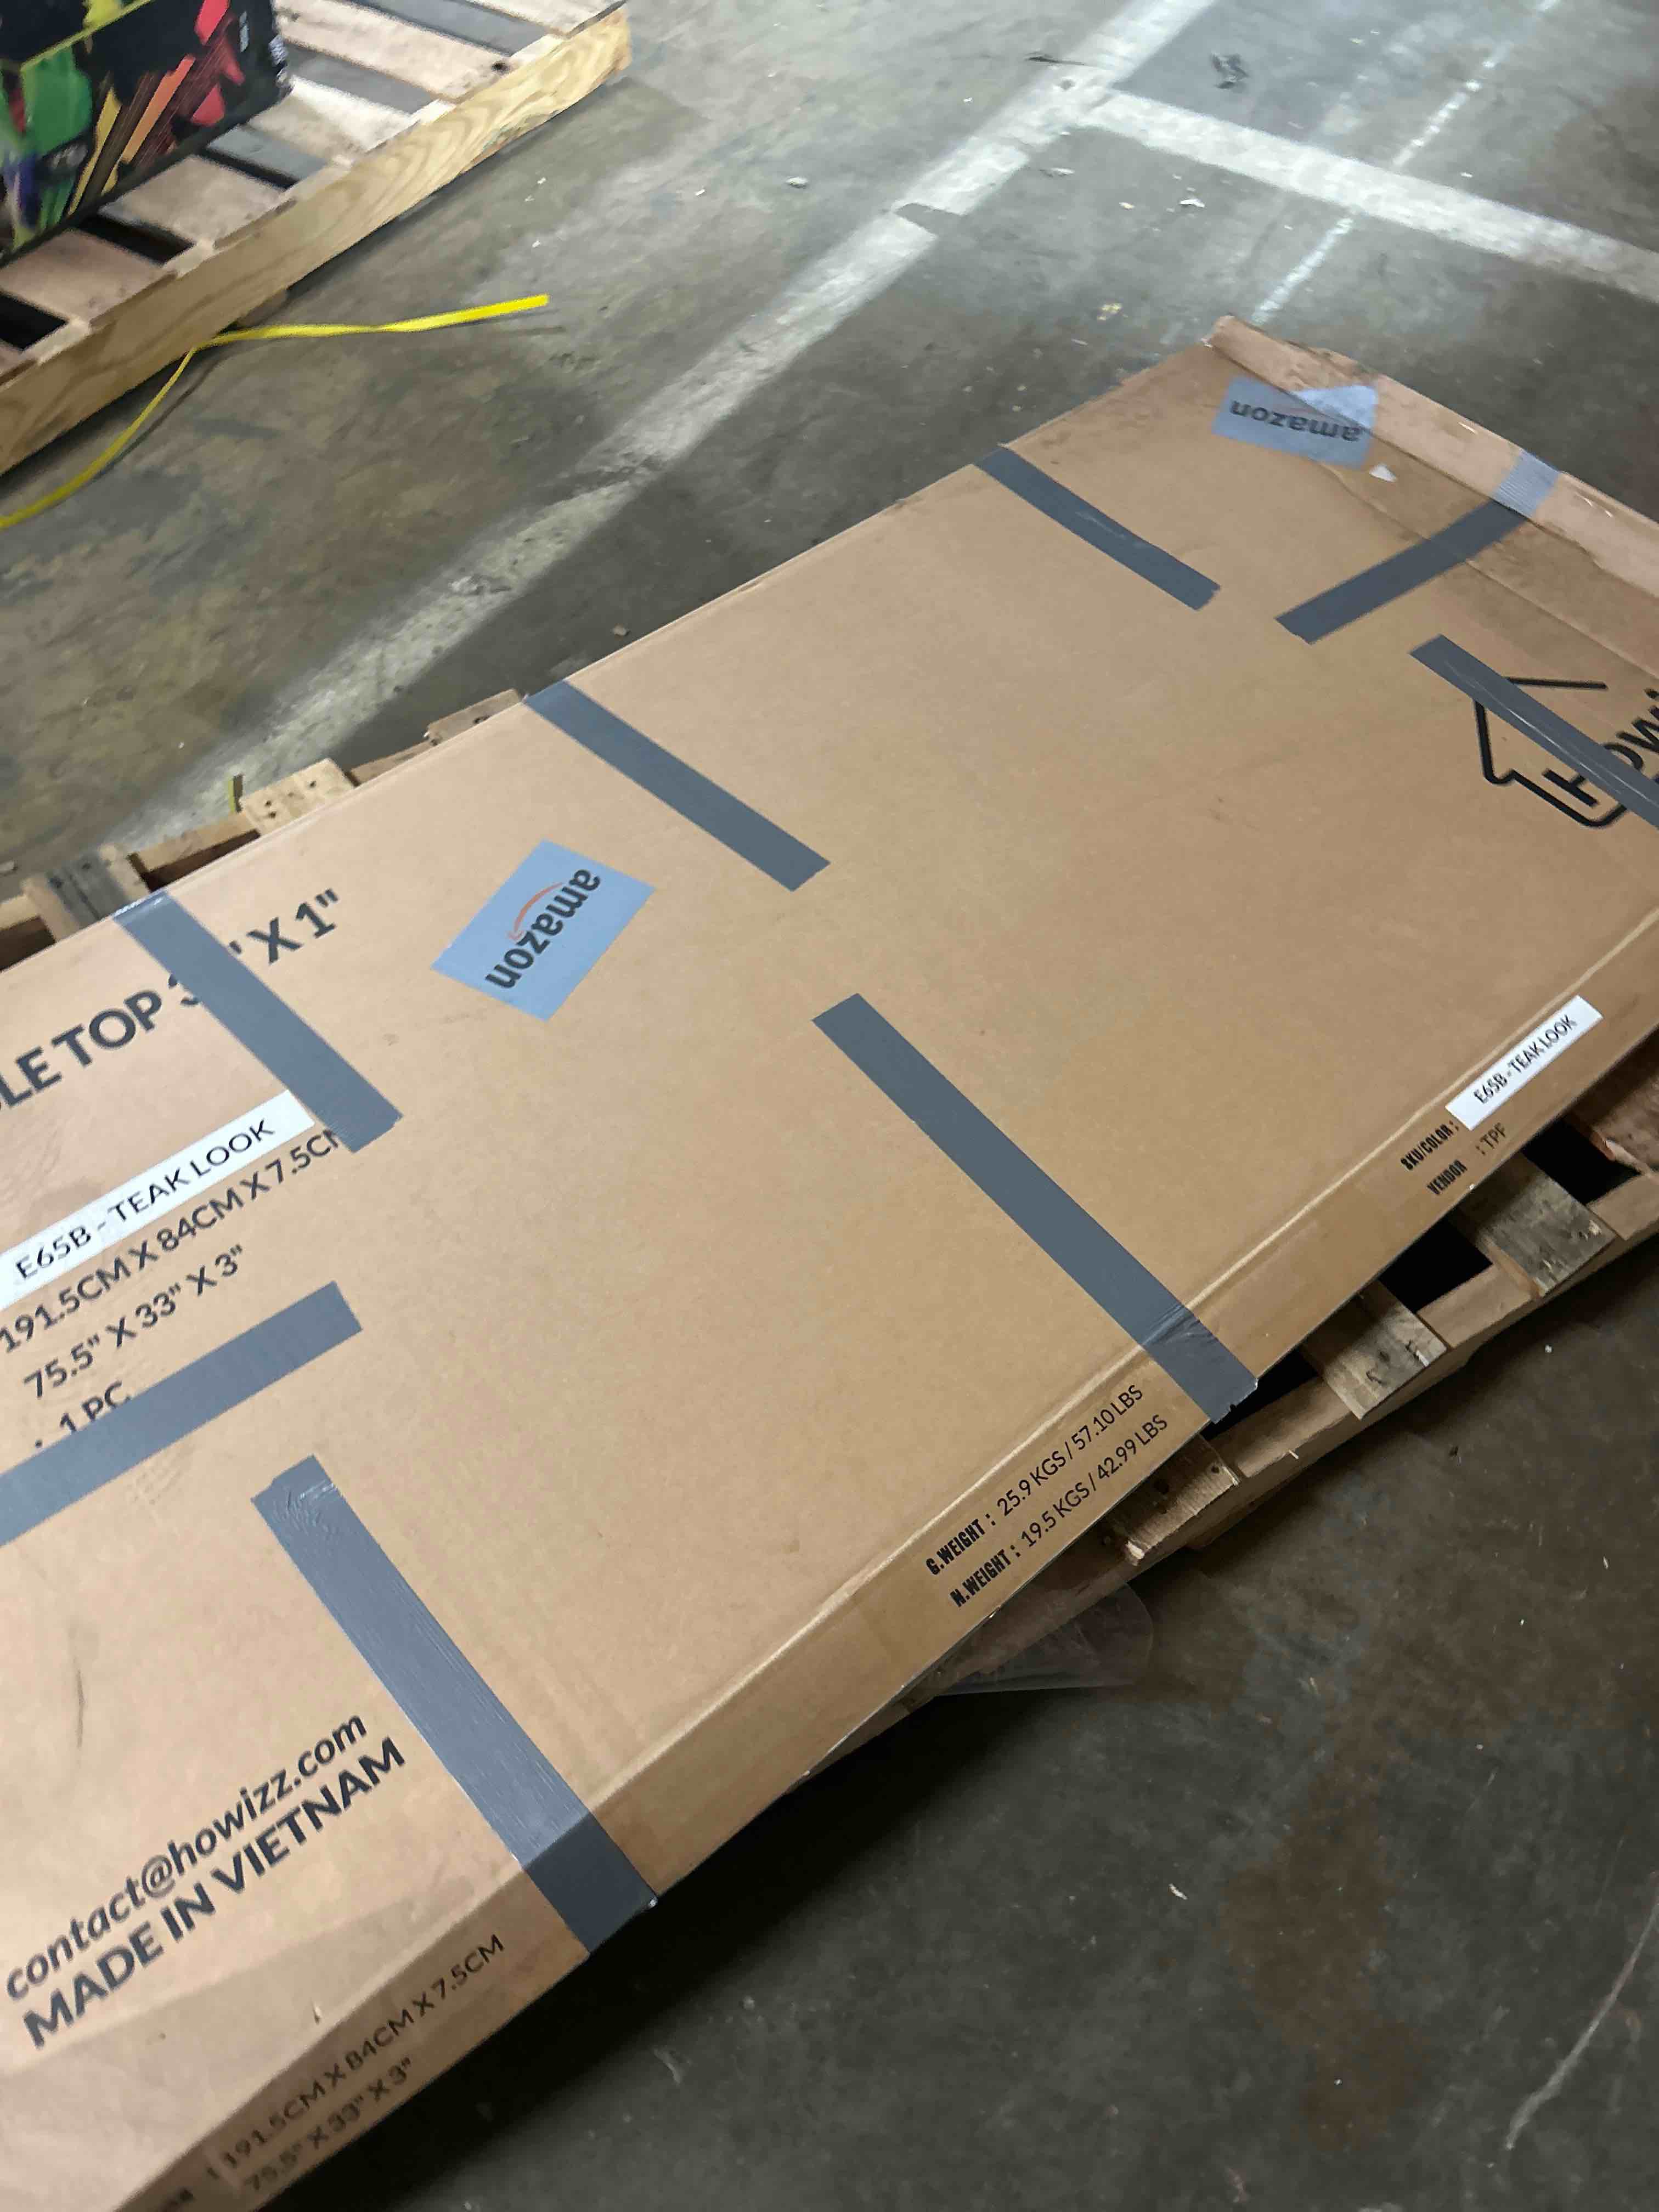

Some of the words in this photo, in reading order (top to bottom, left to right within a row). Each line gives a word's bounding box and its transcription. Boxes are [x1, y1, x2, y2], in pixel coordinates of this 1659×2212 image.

[1229, 398, 1361, 443] amazon
[0, 1046, 61, 1107] LE
[52, 990, 162, 1067] TOP
[246, 917, 303, 964] X
[296, 888, 339, 939] 1"
[485, 869, 601, 988] amazon
[1473, 1073, 1508, 1105] E65B
[1507, 1041, 1544, 1073] TEAK
[1538, 1014, 1577, 1049] LOOK
[16, 1225, 91, 1278] E65B
[97, 1221, 106, 1230] -
[108, 1168, 190, 1222] TEAK
[190, 1119, 274, 1177] LOOK
[1427, 1159, 1468, 1195] VENDOR
[0, 1256, 131, 1352] 191.5CM
[128, 1240, 159, 1272] X
[157, 1187, 244, 1251] 84CM
[240, 1171, 270, 1200] X
[105, 1316, 137, 1348] X
[185, 1264, 218, 1296] X
[82, 1380, 131, 1421] PC
[926, 1519, 985, 1576] G.WEIGHT
[997, 1479, 1032, 1517] 25.9
[1030, 1451, 1066, 1486] KGS
[1064, 1441, 1073, 1460] /
[1071, 1408, 1115, 1451] 57.10
[1110, 1384, 1143, 1415] LBS
[949, 1549, 1012, 1607] N.WEIGHT
[1021, 1511, 1057, 1548] 19.5
[1053, 1482, 1090, 1518] KGS
[1088, 1472, 1097, 1492] /
[1097, 1439, 1137, 1480] 42.99
[1135, 1414, 1167, 1446] LBS
[6, 1714, 367, 2001] contact@howizz.com
[22, 1921, 164, 2049] MADE
[160, 1882, 216, 1943] IN
[210, 1736, 405, 1894] VIETNAM
[324, 2063, 347, 2087] X
[412, 1992, 435, 2017] X
[432, 1934, 505, 1999] 7.5CM
